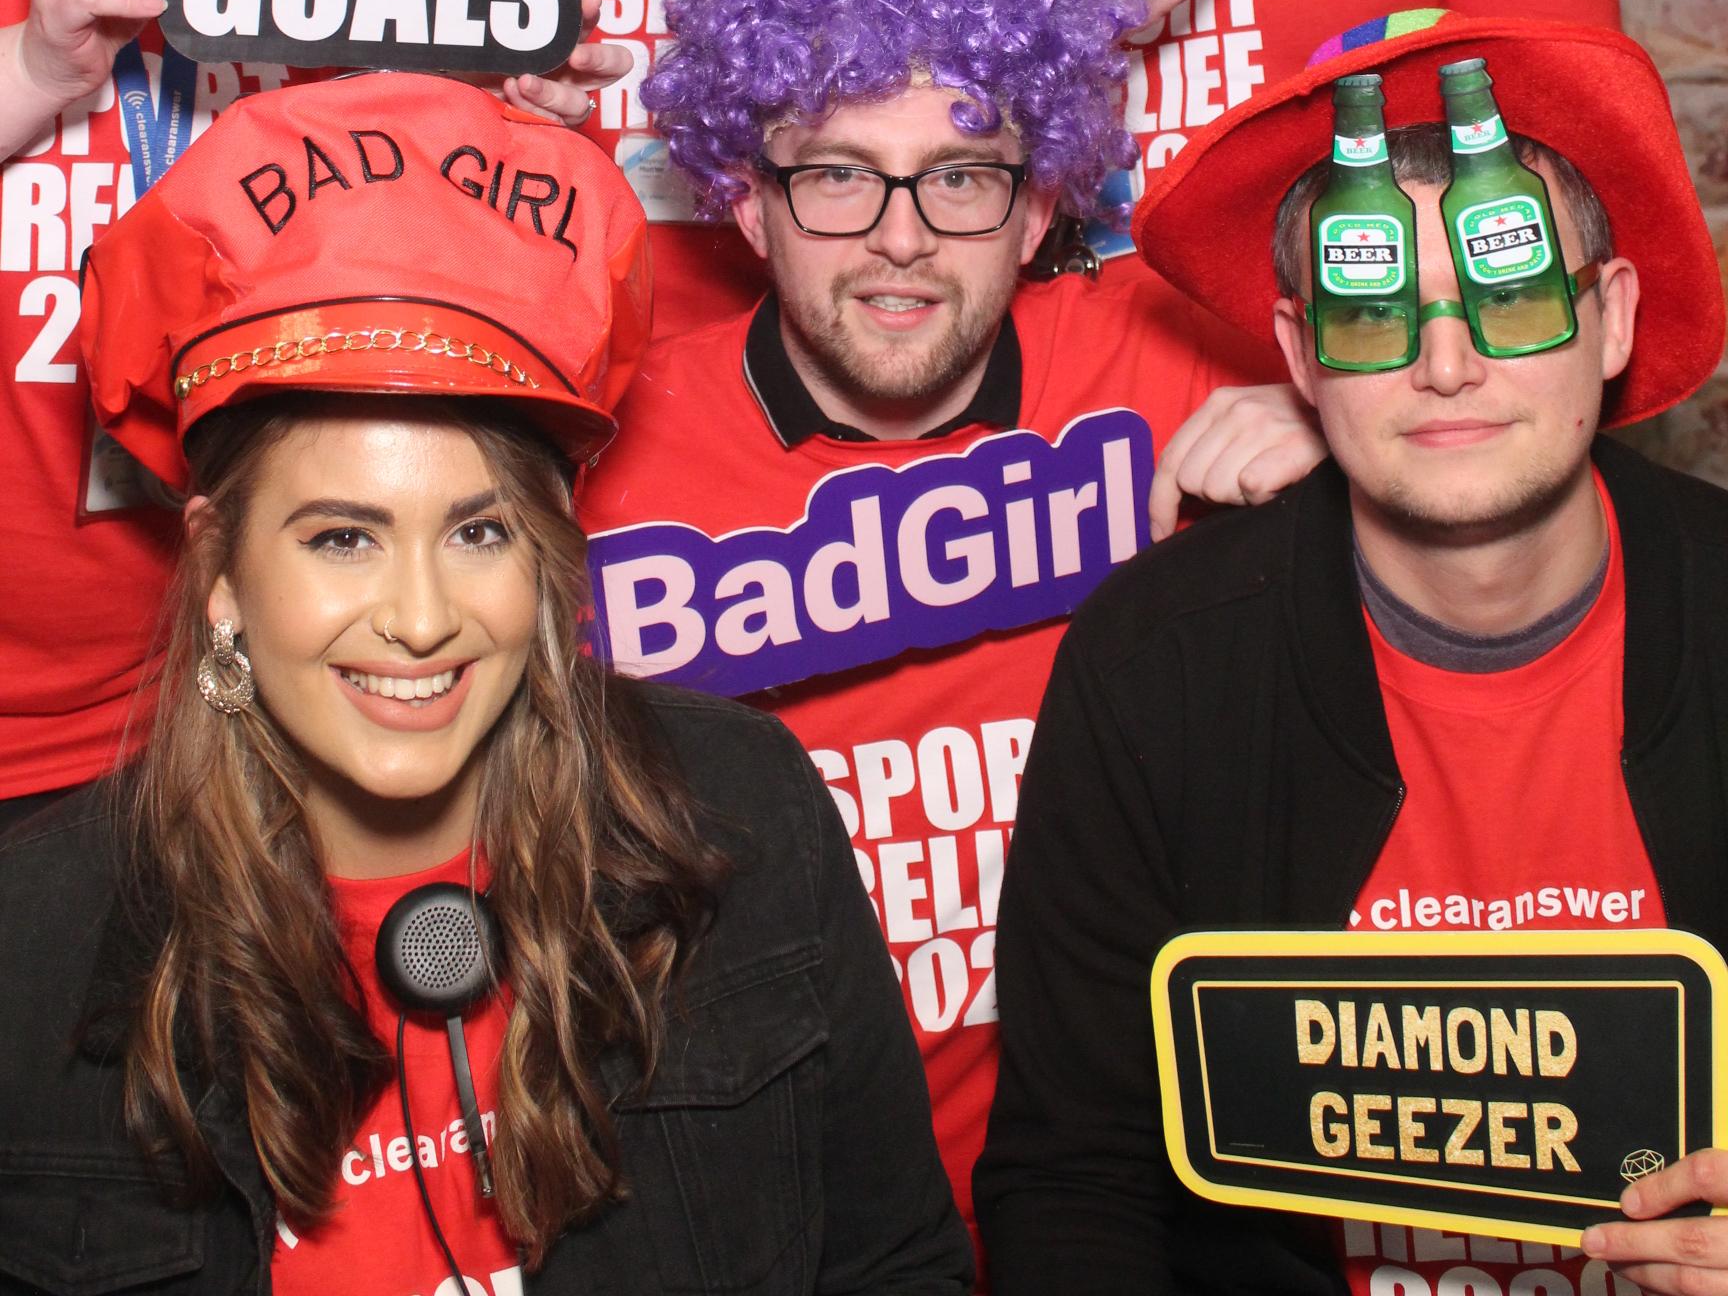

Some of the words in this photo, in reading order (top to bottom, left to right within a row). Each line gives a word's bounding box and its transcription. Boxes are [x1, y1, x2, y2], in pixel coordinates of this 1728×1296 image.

[1346, 147, 1373, 155] BEER
[1463, 129, 1491, 142] BEER
[239, 130, 405, 235] BAD
[440, 145, 578, 262] GIRL
[1327, 247, 1393, 262] BEER
[1470, 227, 1537, 254] BEER
[601, 437, 1138, 680] BadGirl
[1370, 887, 1646, 931] clearanswer
[1294, 999, 1578, 1078] DIAMOND
[1310, 1091, 1582, 1172] GEEZER
